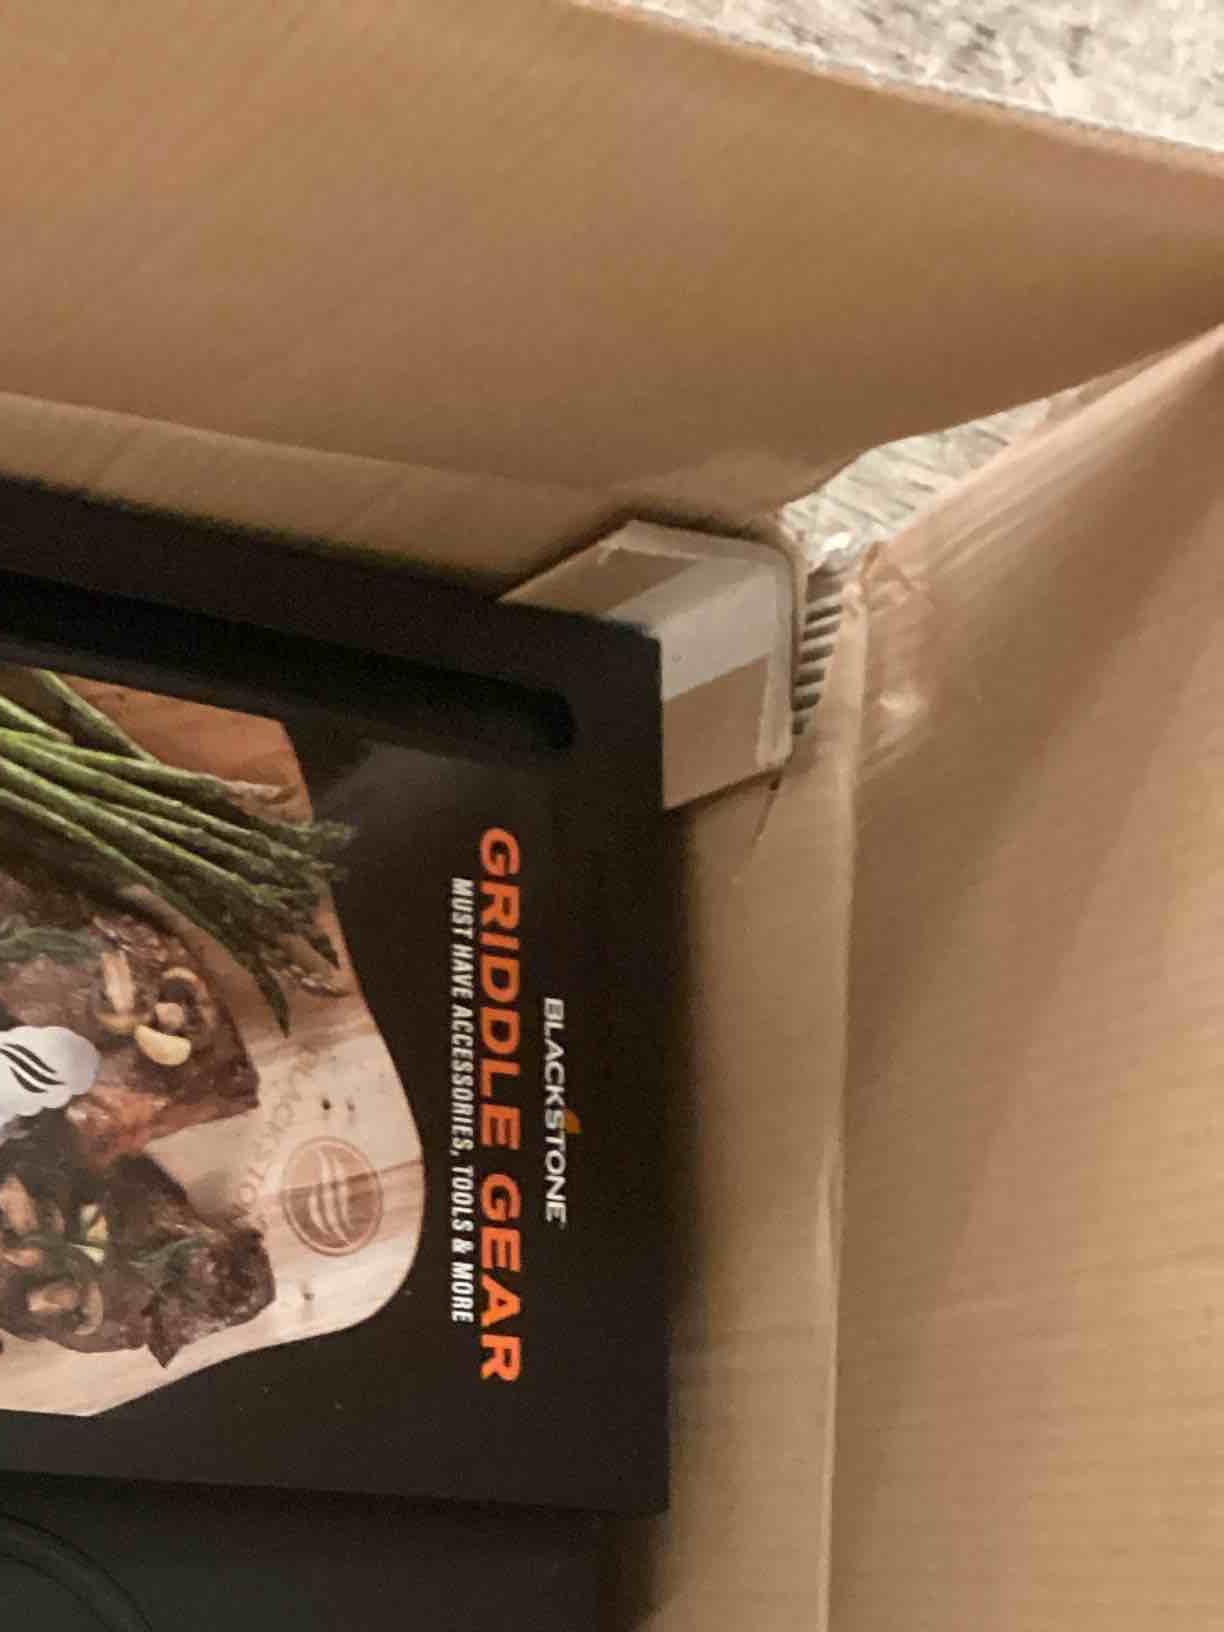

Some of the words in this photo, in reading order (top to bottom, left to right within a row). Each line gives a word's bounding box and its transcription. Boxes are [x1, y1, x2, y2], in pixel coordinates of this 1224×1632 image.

[450, 877, 473, 938] MUST
[450, 944, 473, 999] HAVE
[480, 827, 521, 1150] GRIDDLE
[449, 1004, 474, 1157] ACCESSORIES,
[544, 997, 567, 1223] BLACKSTONE
[451, 1165, 474, 1232] TOOLS
[451, 1238, 473, 1254] &
[481, 1173, 522, 1381] GEAR
[451, 1261, 474, 1323] MORE
